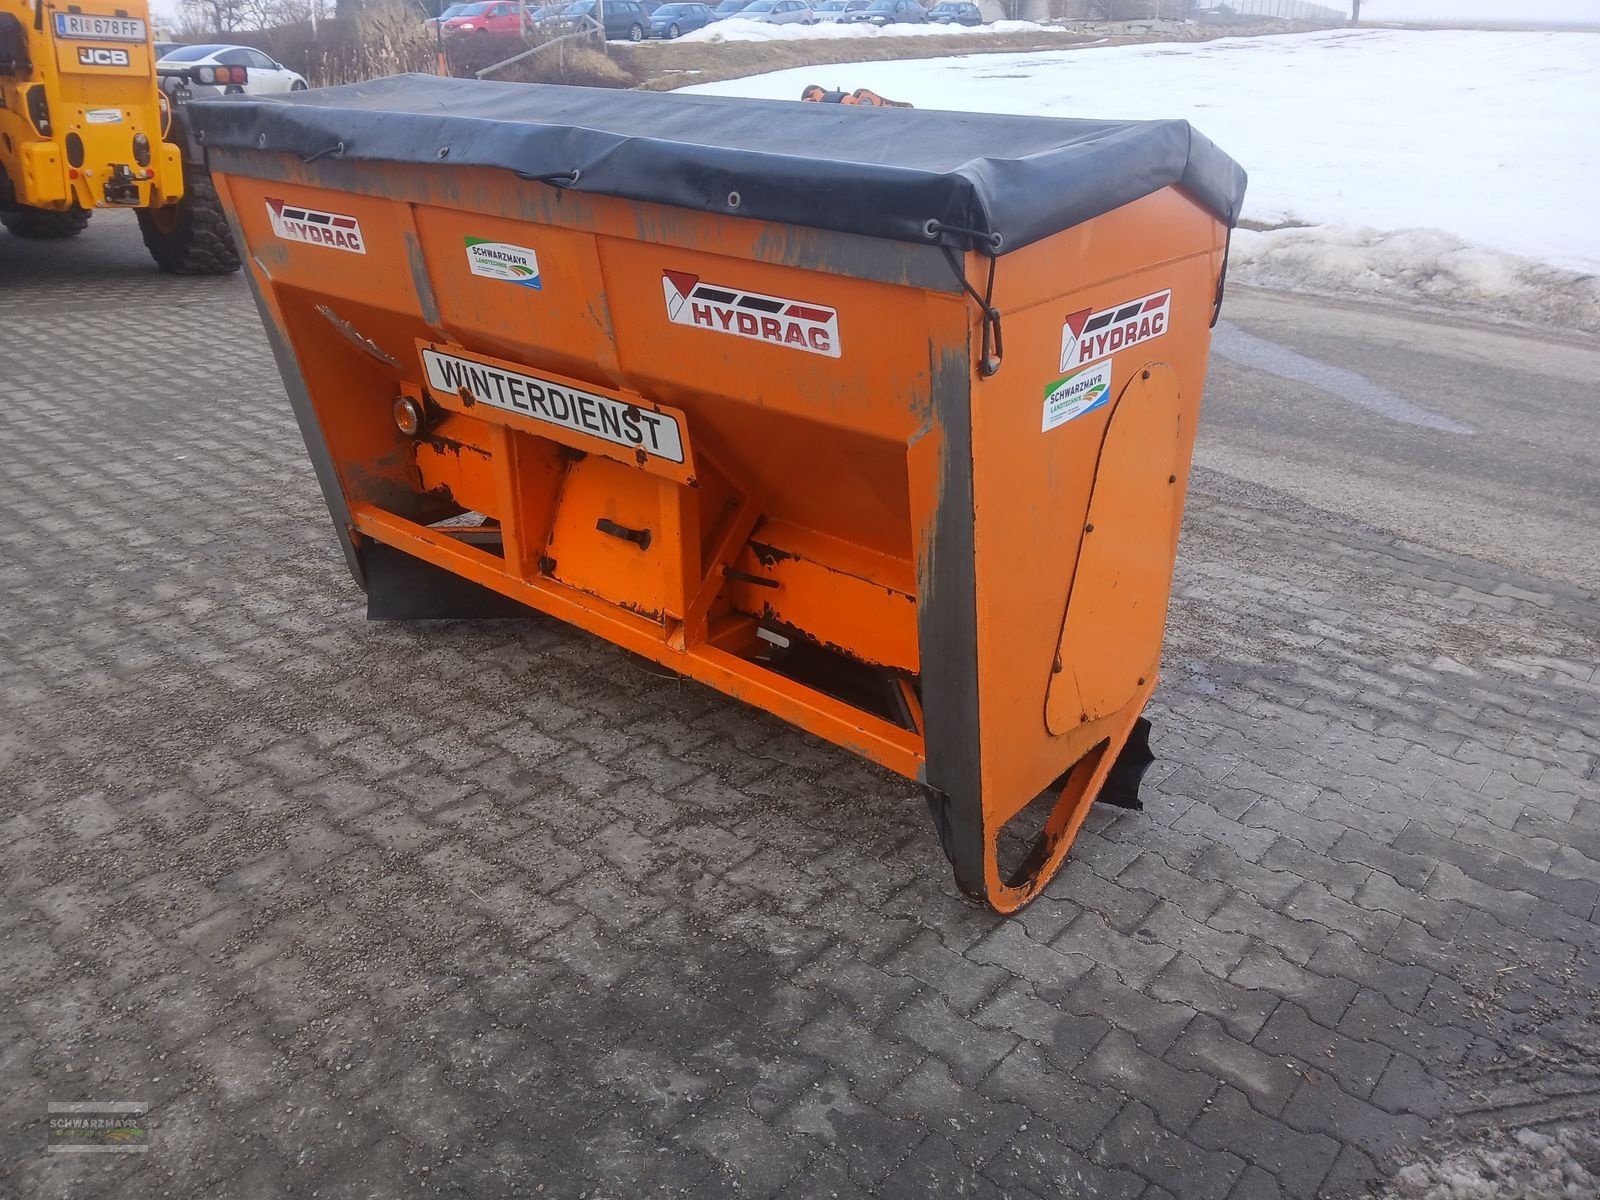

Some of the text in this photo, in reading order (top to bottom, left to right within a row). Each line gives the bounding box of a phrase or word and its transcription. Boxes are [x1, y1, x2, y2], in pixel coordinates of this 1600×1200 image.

[70, 18, 138, 36] RI 678FF
[80, 48, 128, 65] JCB
[283, 220, 361, 251] HYDRAC
[472, 246, 528, 266] SCHWARZMAYR
[692, 302, 830, 351] HYDRAC
[1079, 312, 1164, 363] HYDRAC
[435, 357, 661, 450] WINTERDIENST
[1050, 374, 1103, 404] SCHWARZMAYR
